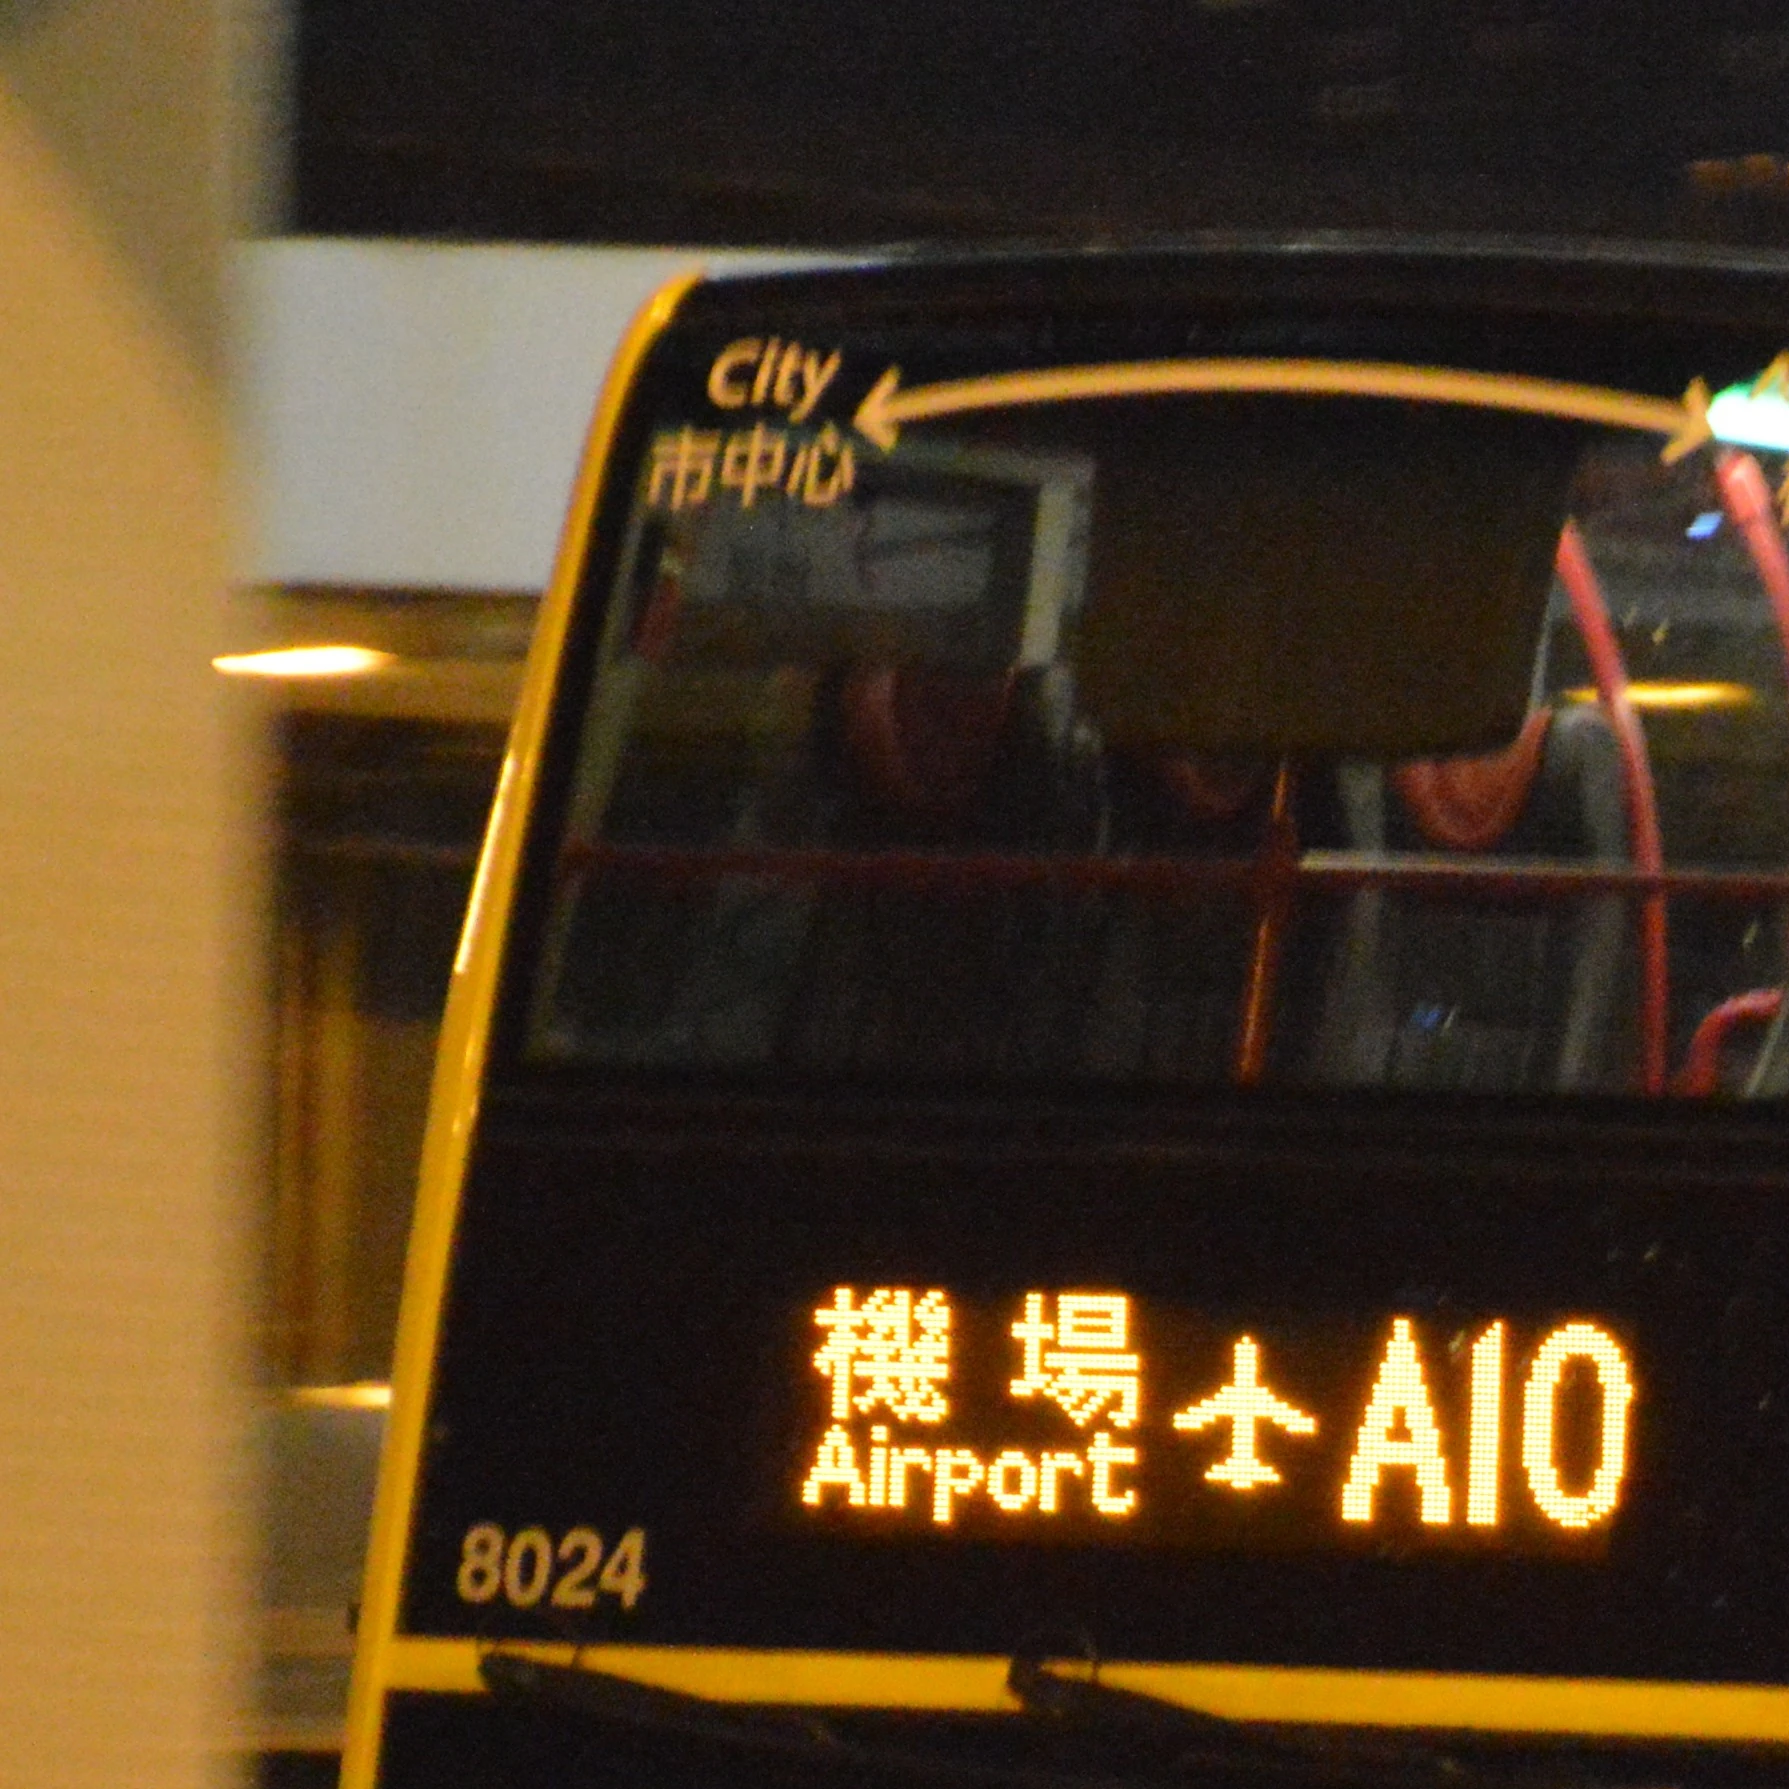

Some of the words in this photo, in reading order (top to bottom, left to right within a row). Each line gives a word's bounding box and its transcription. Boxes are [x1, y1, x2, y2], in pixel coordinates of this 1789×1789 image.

[707, 336, 843, 422] City
[648, 421, 857, 510] 市中心
[813, 1287, 1141, 1428] 機場
[1340, 1317, 1635, 1528] A10
[802, 1424, 1137, 1522] Airport
[456, 1521, 648, 1614] 8024
